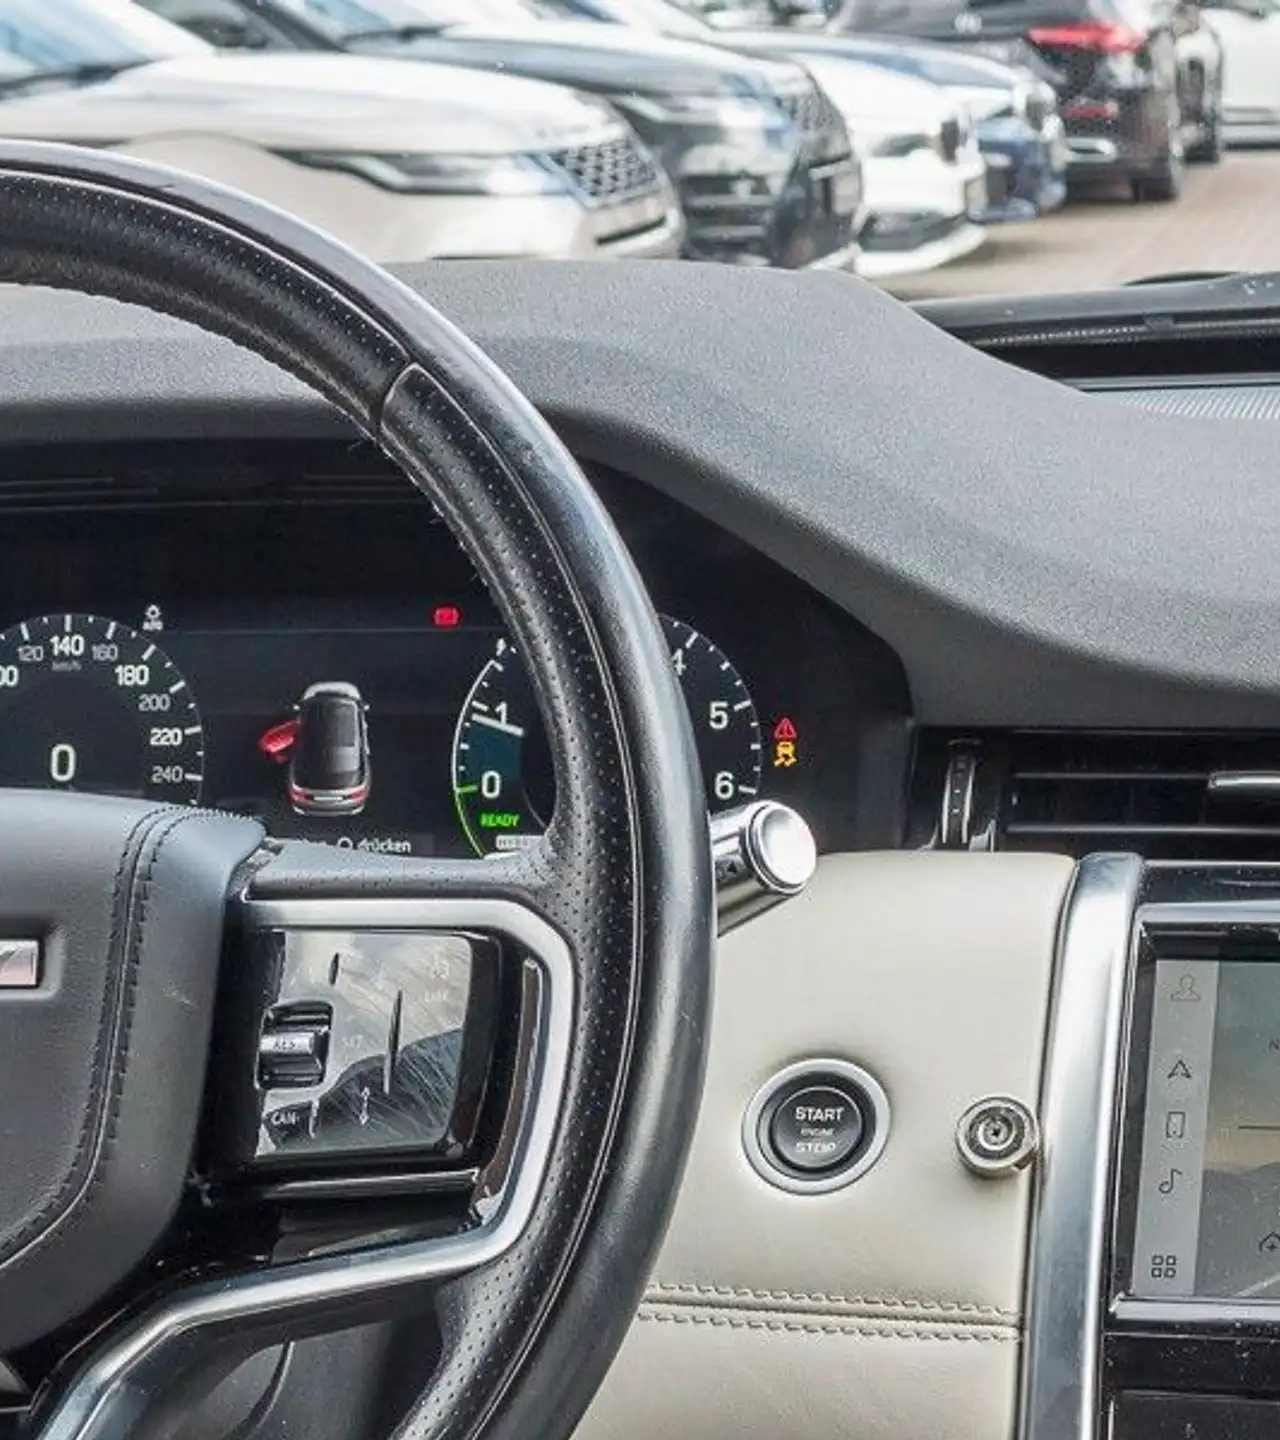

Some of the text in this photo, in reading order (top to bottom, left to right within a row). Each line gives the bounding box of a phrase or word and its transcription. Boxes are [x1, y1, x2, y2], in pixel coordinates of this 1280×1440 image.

[17, 645, 44, 661] 120
[50, 634, 84, 656] 140
[115, 664, 149, 686] 180
[138, 694, 171, 712] 200
[709, 701, 728, 730] 5
[150, 728, 183, 746] 220
[50, 744, 76, 782] 0
[151, 766, 183, 783] 240
[481, 771, 501, 798] 0
[714, 771, 734, 799] 6
[480, 814, 520, 828] READY
[795, 1106, 845, 1121] START
[795, 1142, 837, 1153] STOP
